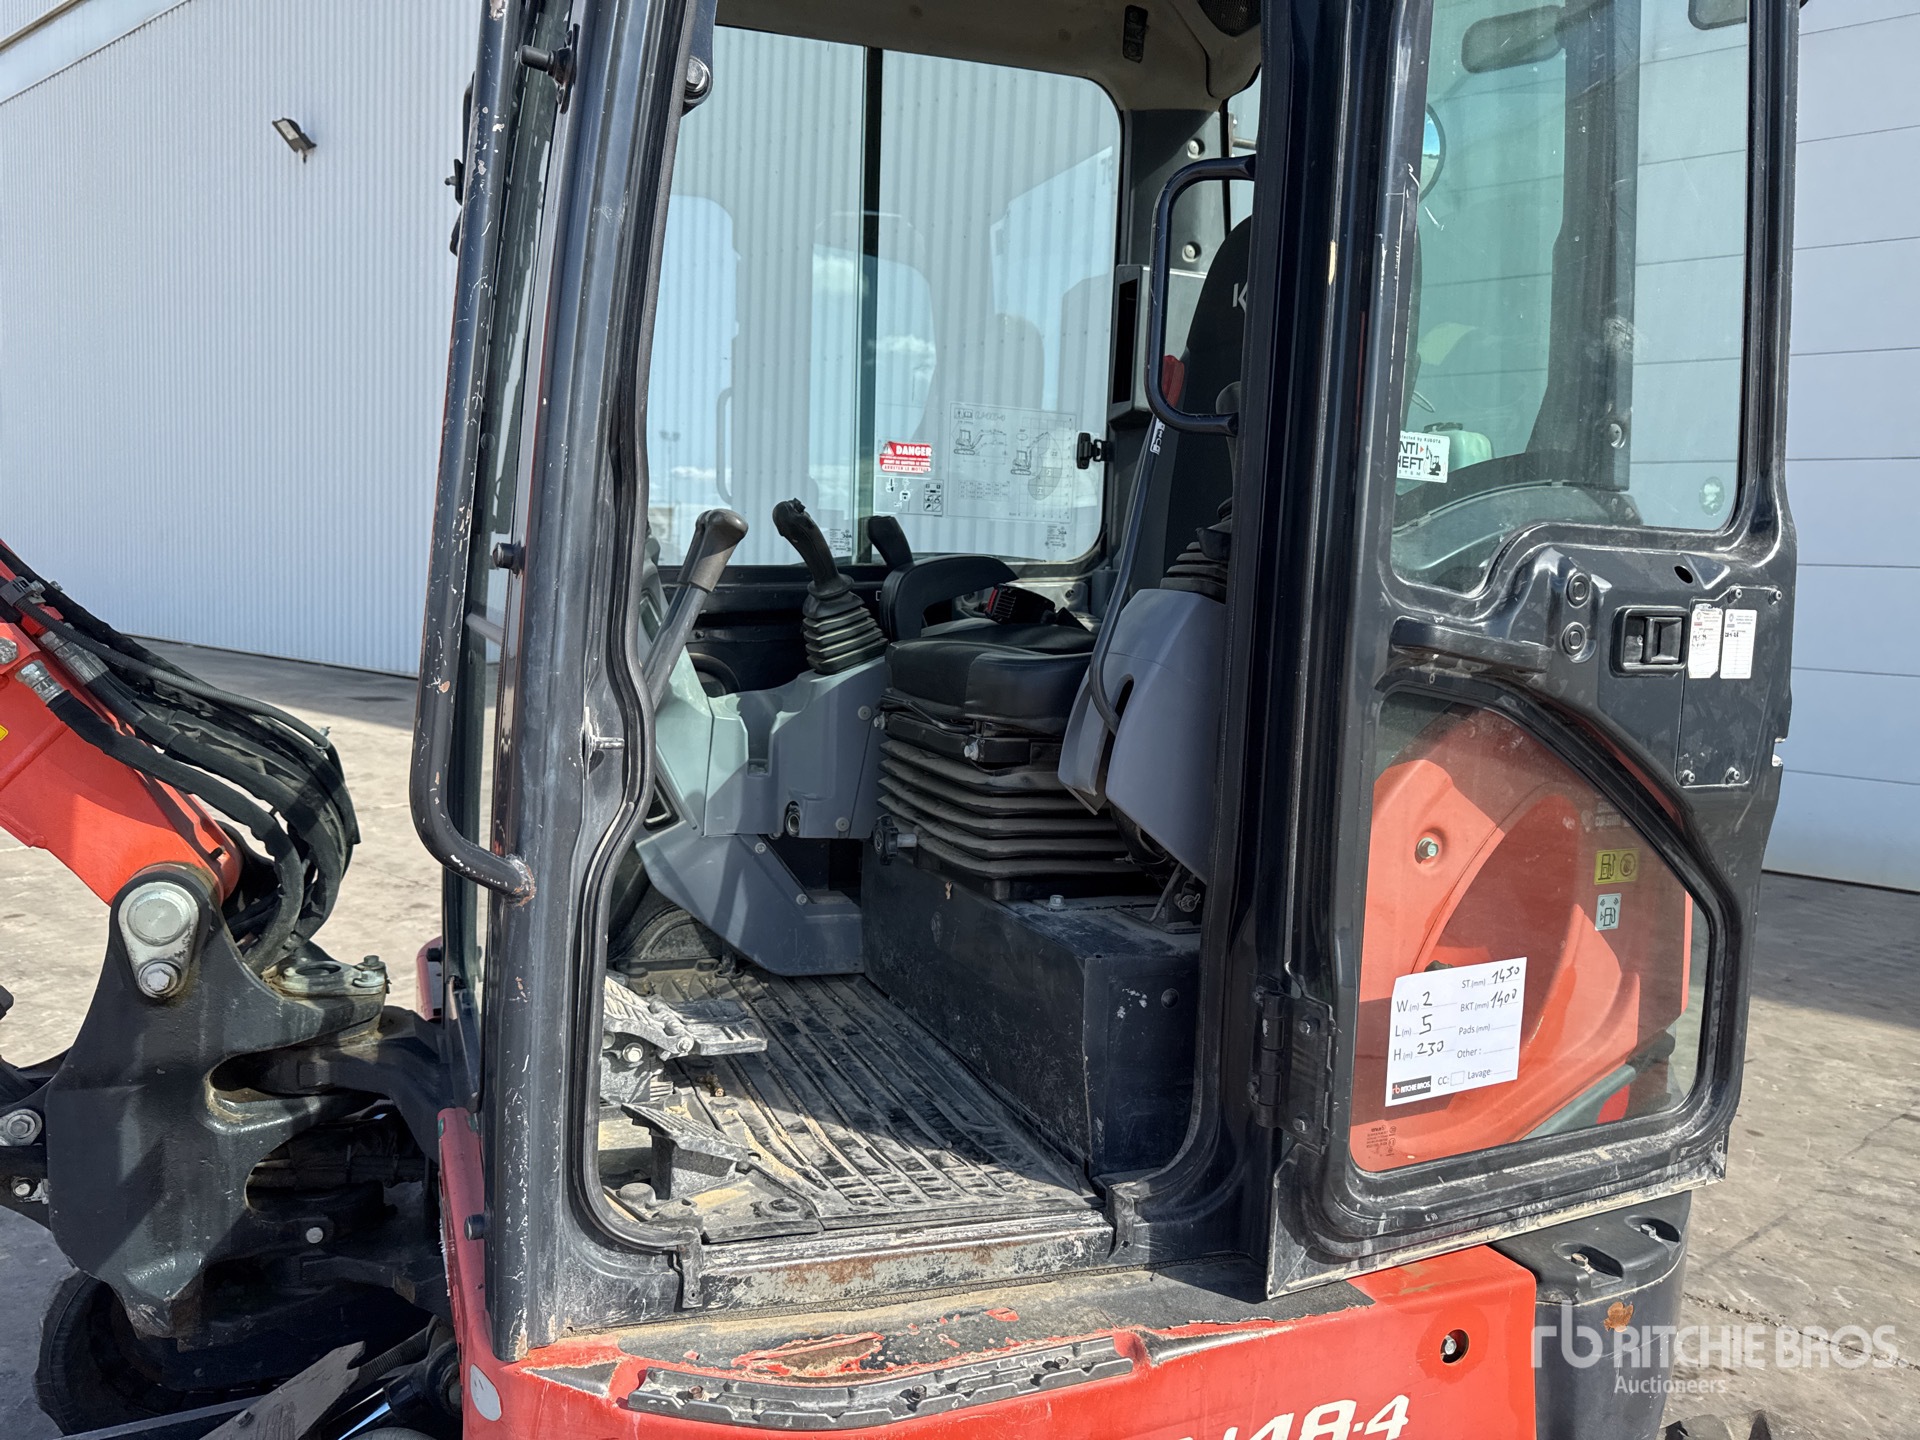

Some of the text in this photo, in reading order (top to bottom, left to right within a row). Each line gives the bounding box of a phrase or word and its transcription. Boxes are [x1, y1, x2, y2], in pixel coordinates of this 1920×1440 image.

[895, 445, 932, 457] DANGER
[1399, 440, 1419, 455] NTI
[1397, 455, 1424, 470] HEFT
[1422, 990, 1433, 1007] 2
[1419, 1013, 1433, 1036] 5
